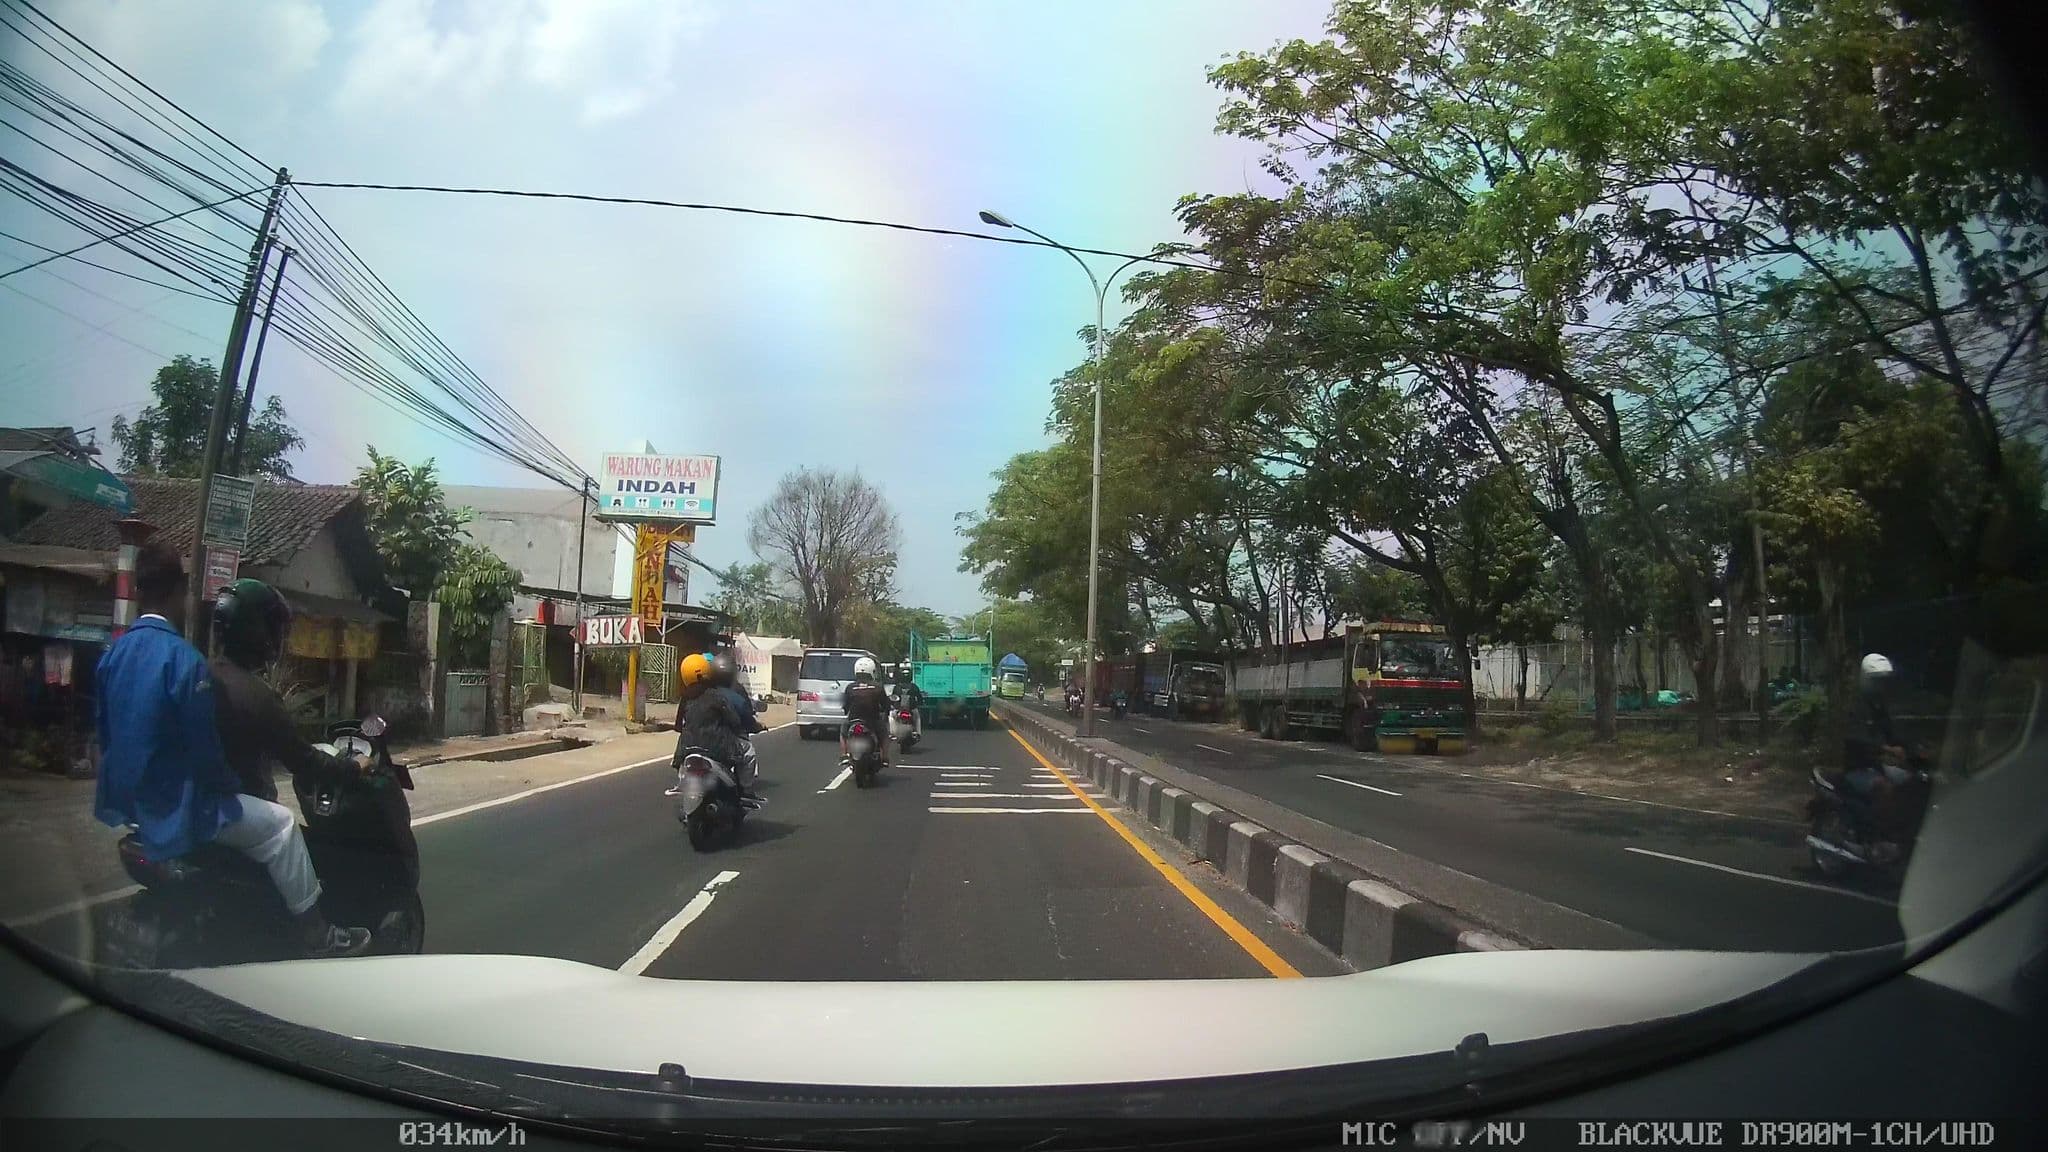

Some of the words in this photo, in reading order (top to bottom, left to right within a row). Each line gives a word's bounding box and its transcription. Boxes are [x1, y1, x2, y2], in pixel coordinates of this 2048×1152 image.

[608, 456, 661, 476] WARUNG
[664, 458, 713, 478] MAKAN
[617, 479, 696, 494] INDAH
[584, 616, 642, 645] BUKA
